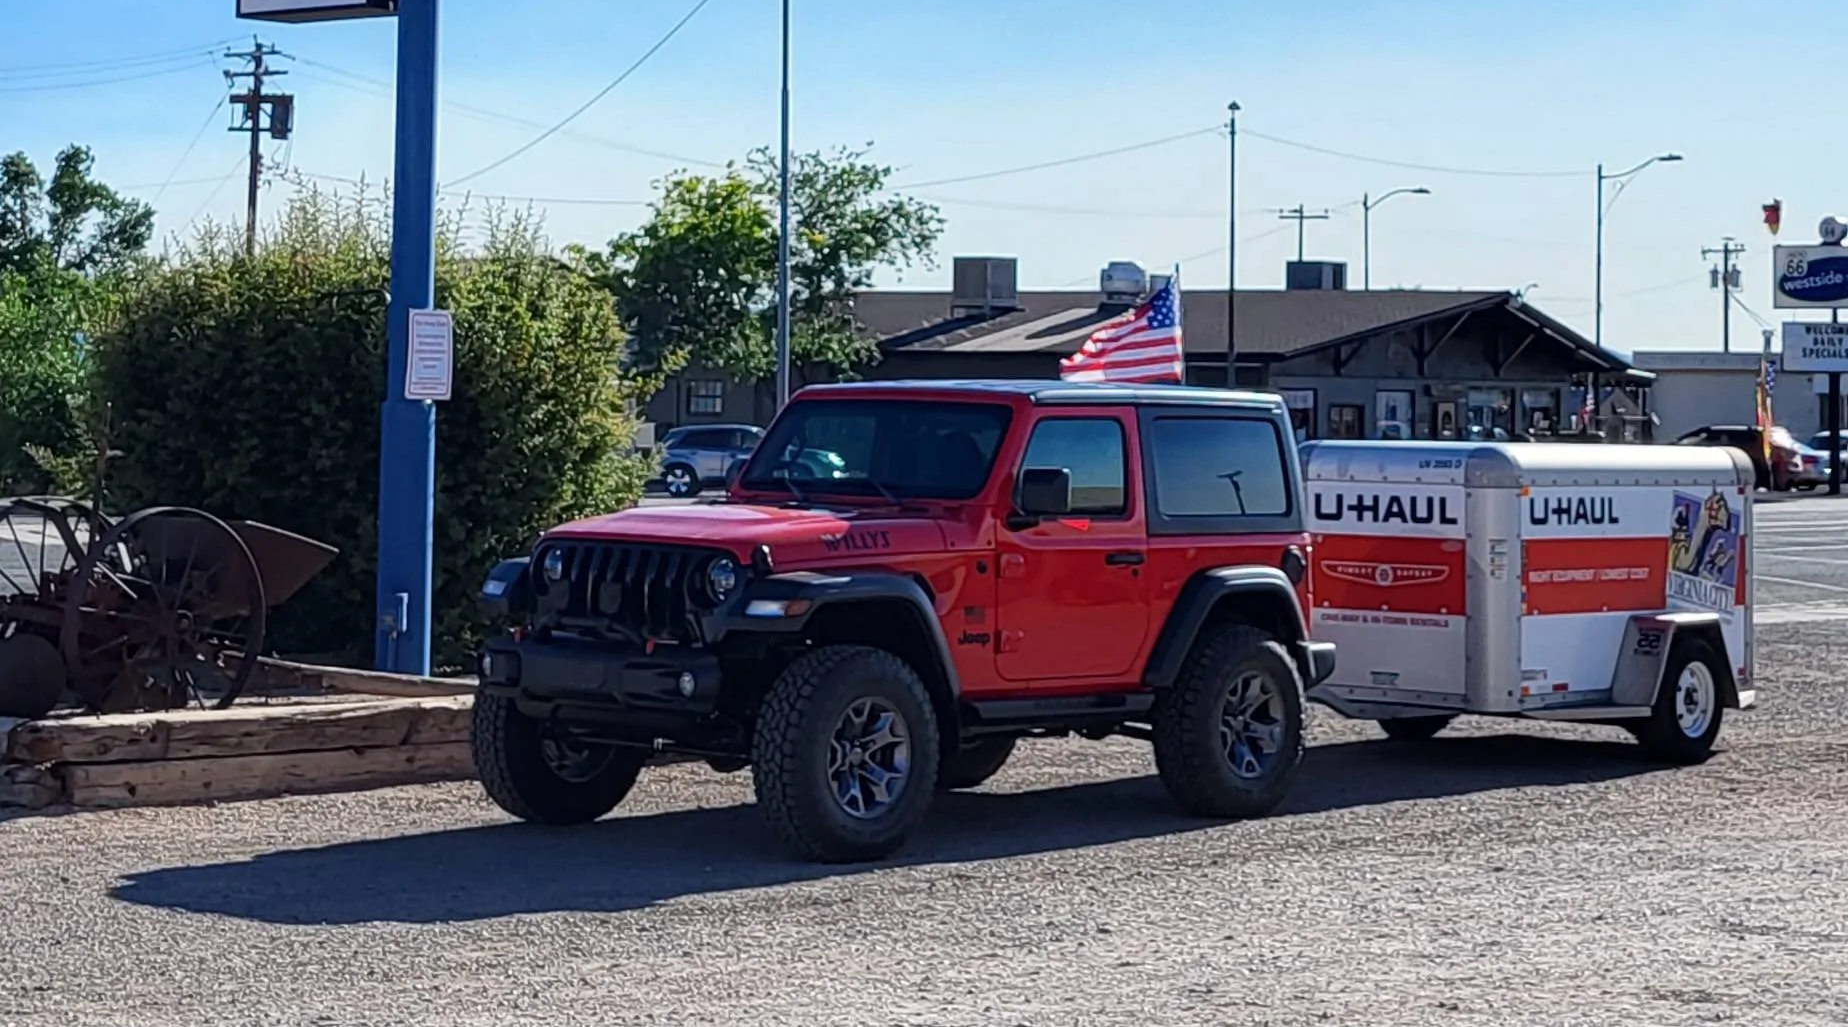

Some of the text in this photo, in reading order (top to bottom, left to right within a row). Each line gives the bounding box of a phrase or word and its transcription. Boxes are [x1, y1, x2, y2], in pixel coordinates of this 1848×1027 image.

[1786, 258, 1805, 276] 66
[1783, 269, 1844, 291] westside
[1804, 325, 1848, 336] WELCOM
[1314, 493, 1458, 525] U-HAUL
[1529, 496, 1620, 525] U-HAUL
[819, 529, 891, 552] WILLYS
[957, 628, 991, 648] Jeep
